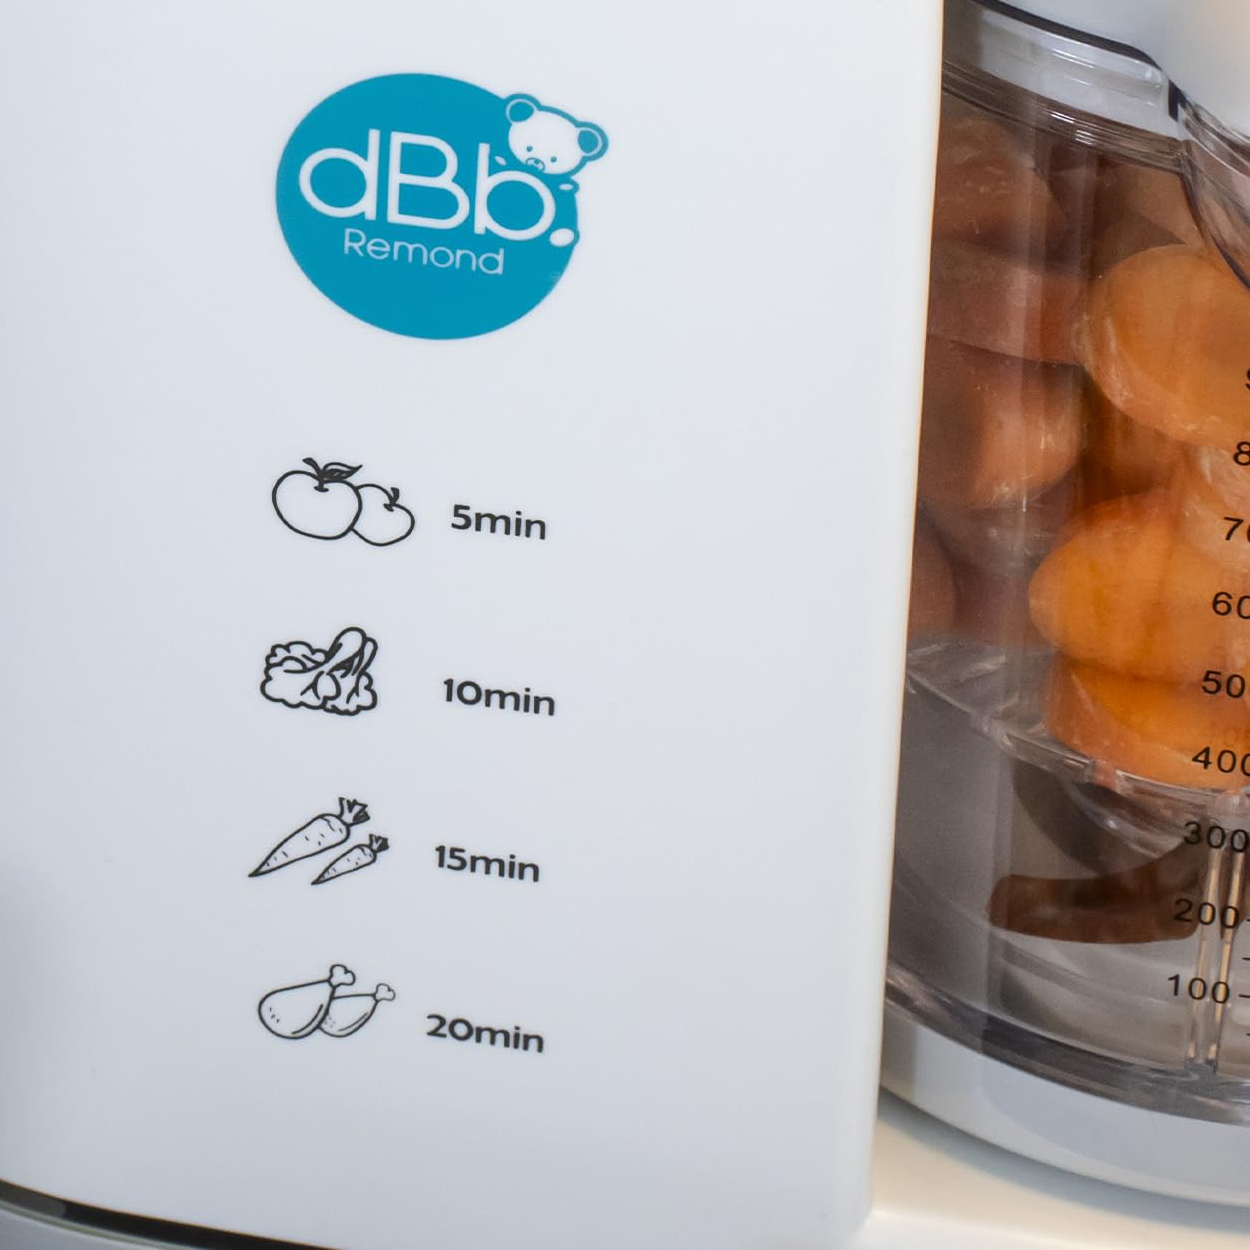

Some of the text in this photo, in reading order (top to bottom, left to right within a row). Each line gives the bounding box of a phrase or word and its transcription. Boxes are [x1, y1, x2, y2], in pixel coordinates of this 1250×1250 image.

[343, 228, 506, 275] Remond
[451, 504, 547, 540] 5min
[1223, 516, 1250, 543] 7
[443, 678, 556, 717] 10min
[1183, 820, 1250, 853] 300
[434, 845, 540, 883] 15min
[1172, 897, 1241, 930] 200
[1167, 972, 1231, 1005] 100
[426, 1013, 544, 1054] 20min
